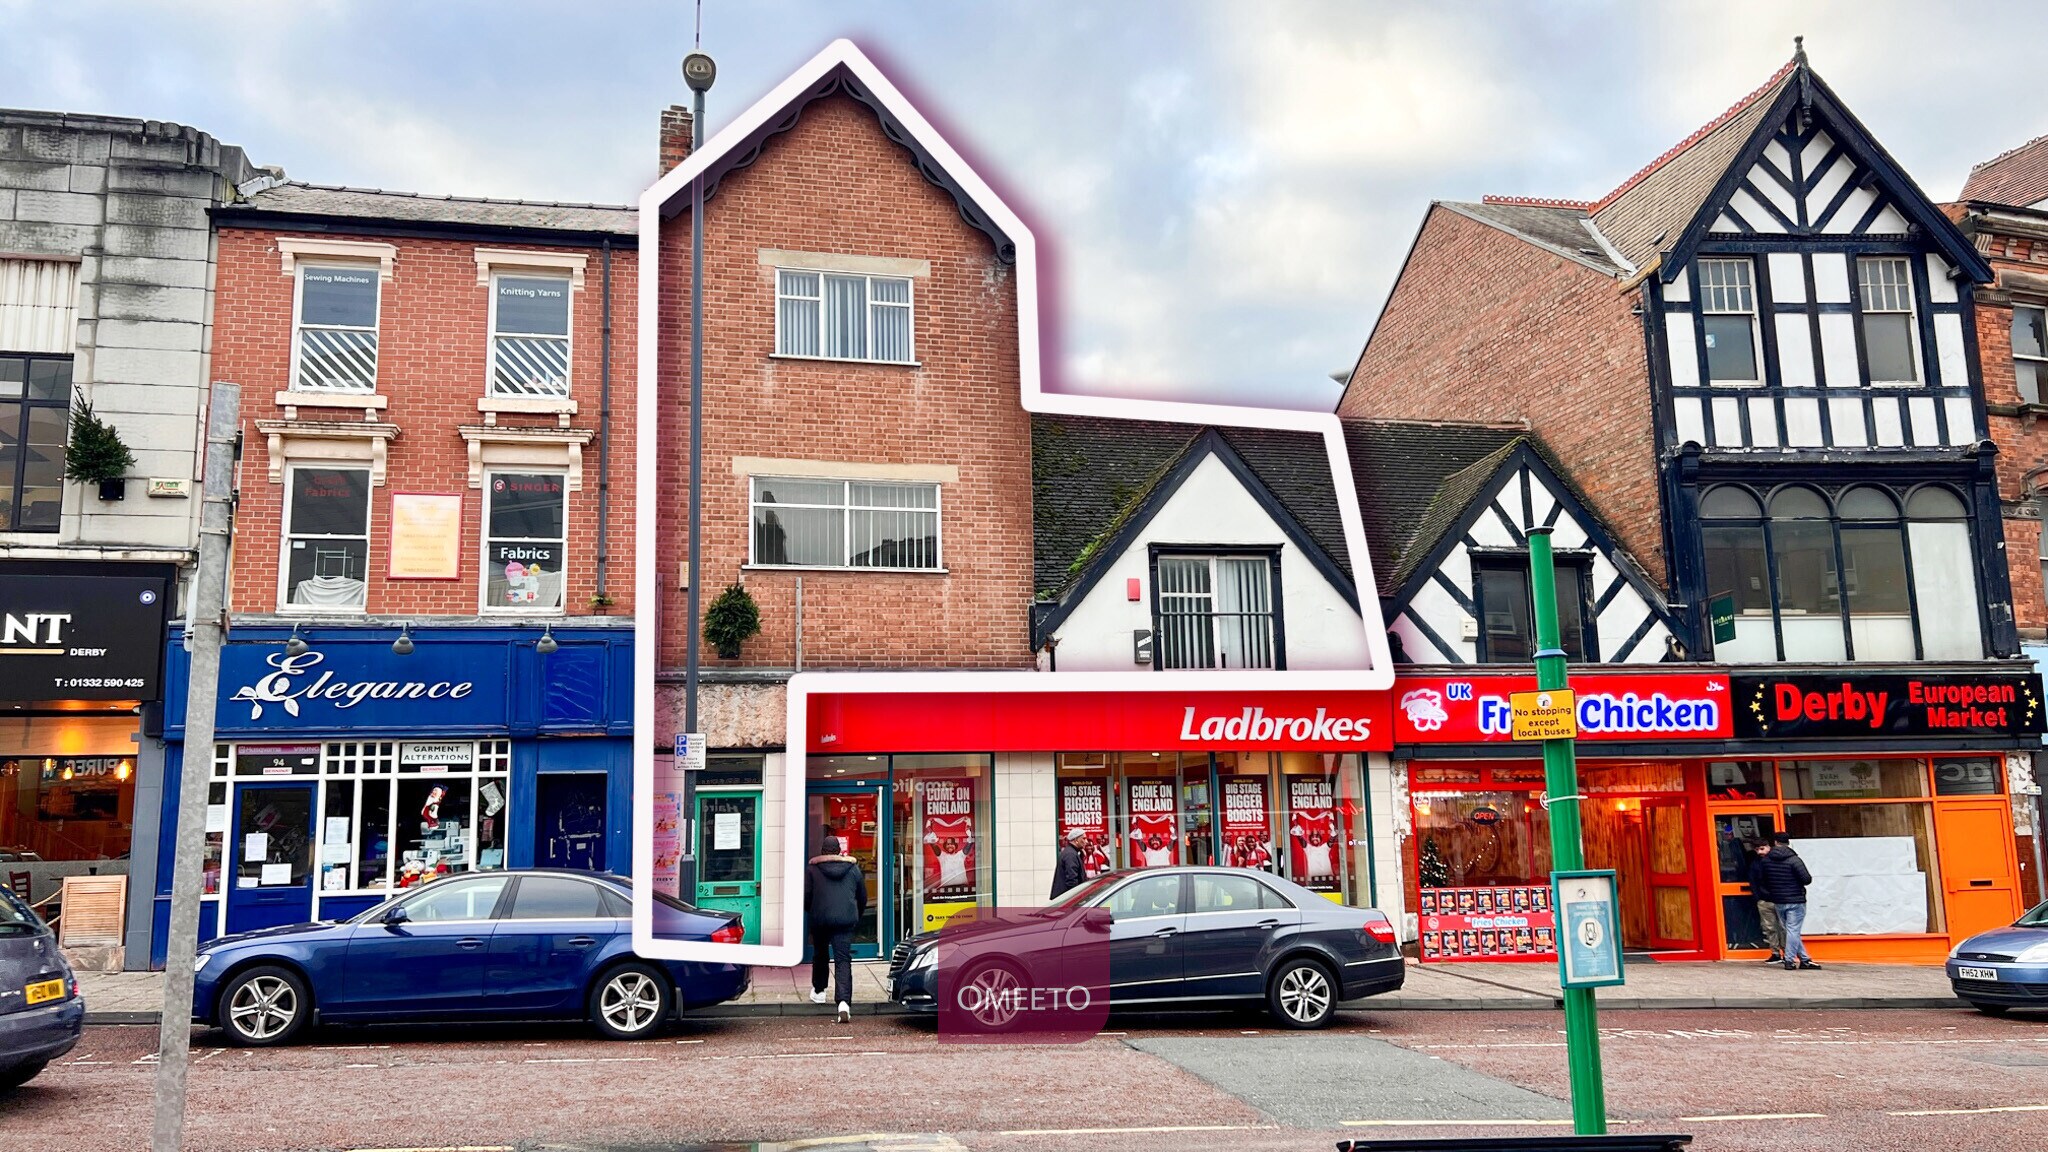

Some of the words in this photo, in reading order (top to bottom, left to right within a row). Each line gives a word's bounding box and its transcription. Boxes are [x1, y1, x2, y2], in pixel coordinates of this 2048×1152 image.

[304, 273, 331, 282] Sewing
[334, 275, 369, 284] Machines
[501, 286, 535, 298] Knitting
[538, 288, 561, 299] Yarns
[510, 483, 560, 491] SINGER
[500, 546, 551, 560] Fabrics
[69, 648, 107, 657] DERBY
[70, 678, 102, 687] 01332
[103, 678, 123, 687] 590
[124, 678, 144, 687] 425
[255, 652, 474, 708] Elegance
[1447, 685, 1472, 699] UK
[1908, 681, 2016, 708] European
[1531, 706, 1572, 716] stopping
[1774, 683, 1888, 728] Derby
[1580, 698, 1714, 730] Chicken
[1928, 707, 2008, 729] Market
[1180, 706, 1372, 741] Ladbrokes
[1528, 718, 1560, 727] except
[1518, 728, 1542, 737] local
[1544, 728, 1571, 737] buses
[273, 758, 284, 767] 94
[927, 787, 955, 801] COME
[956, 787, 970, 801] ON
[1064, 786, 1077, 796] BIG
[1078, 786, 1101, 796] STAGE
[1132, 785, 1158, 798] COME
[1160, 785, 1173, 798] ON
[1225, 784, 1238, 794] BIG
[1239, 784, 1262, 794] STAGE
[1291, 783, 1317, 795] COME
[1319, 783, 1332, 795] ON
[927, 801, 970, 815] ENGLAND
[1064, 797, 1102, 811] BIGGER
[1132, 798, 1173, 812] ENGLAND
[1226, 795, 1263, 808] BIGGER
[1292, 795, 1333, 809] ENGLAND
[1065, 811, 1102, 825] BOOSTS
[1227, 808, 1264, 822] BOOSTS
[1474, 811, 1496, 821] OPEN
[699, 885, 710, 897] 92
[1494, 917, 1528, 926] Chicken
